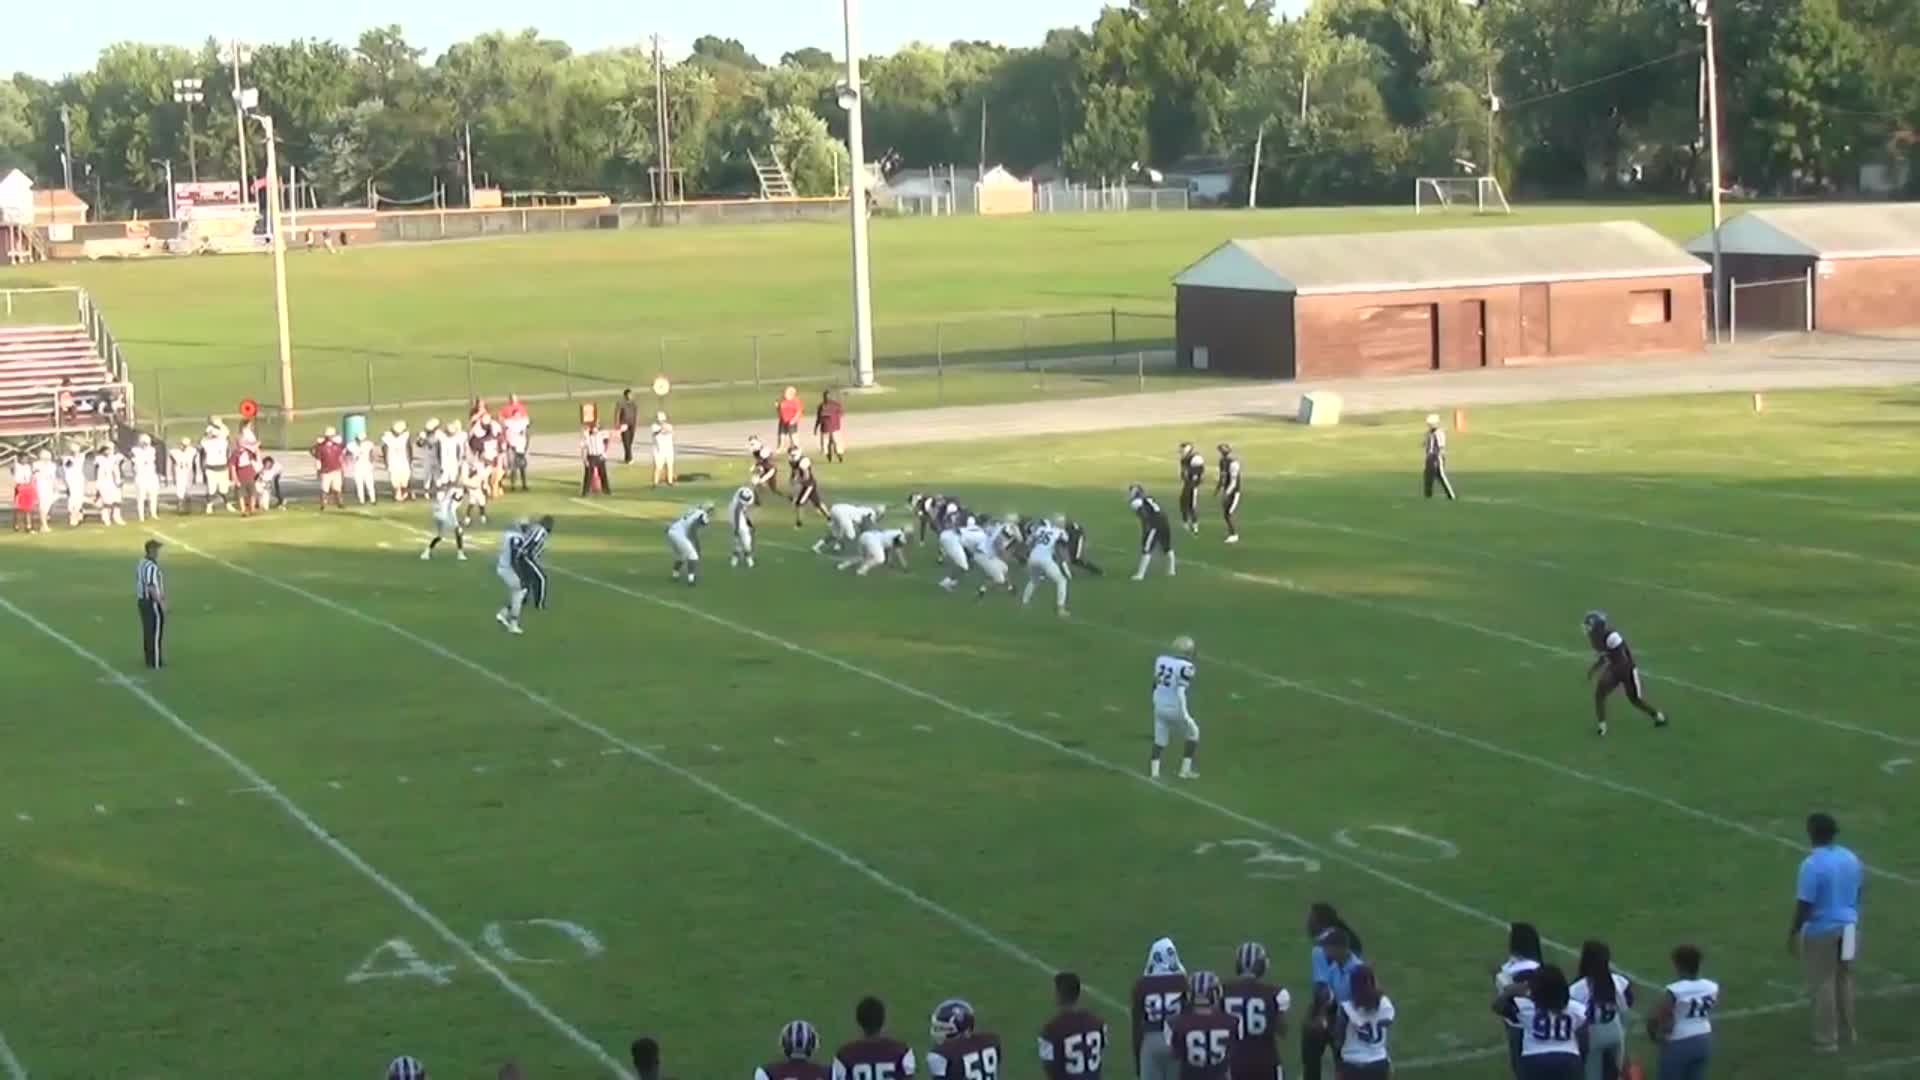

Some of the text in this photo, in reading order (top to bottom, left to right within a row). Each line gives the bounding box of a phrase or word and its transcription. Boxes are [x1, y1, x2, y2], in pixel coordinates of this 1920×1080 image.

[345, 918, 605, 985] 40
[1225, 997, 1267, 1040] 56
[1532, 1010, 1572, 1041] 90
[962, 1047, 998, 1080] 59
[1063, 1031, 1102, 1074] 53
[1185, 1029, 1230, 1067] 65
